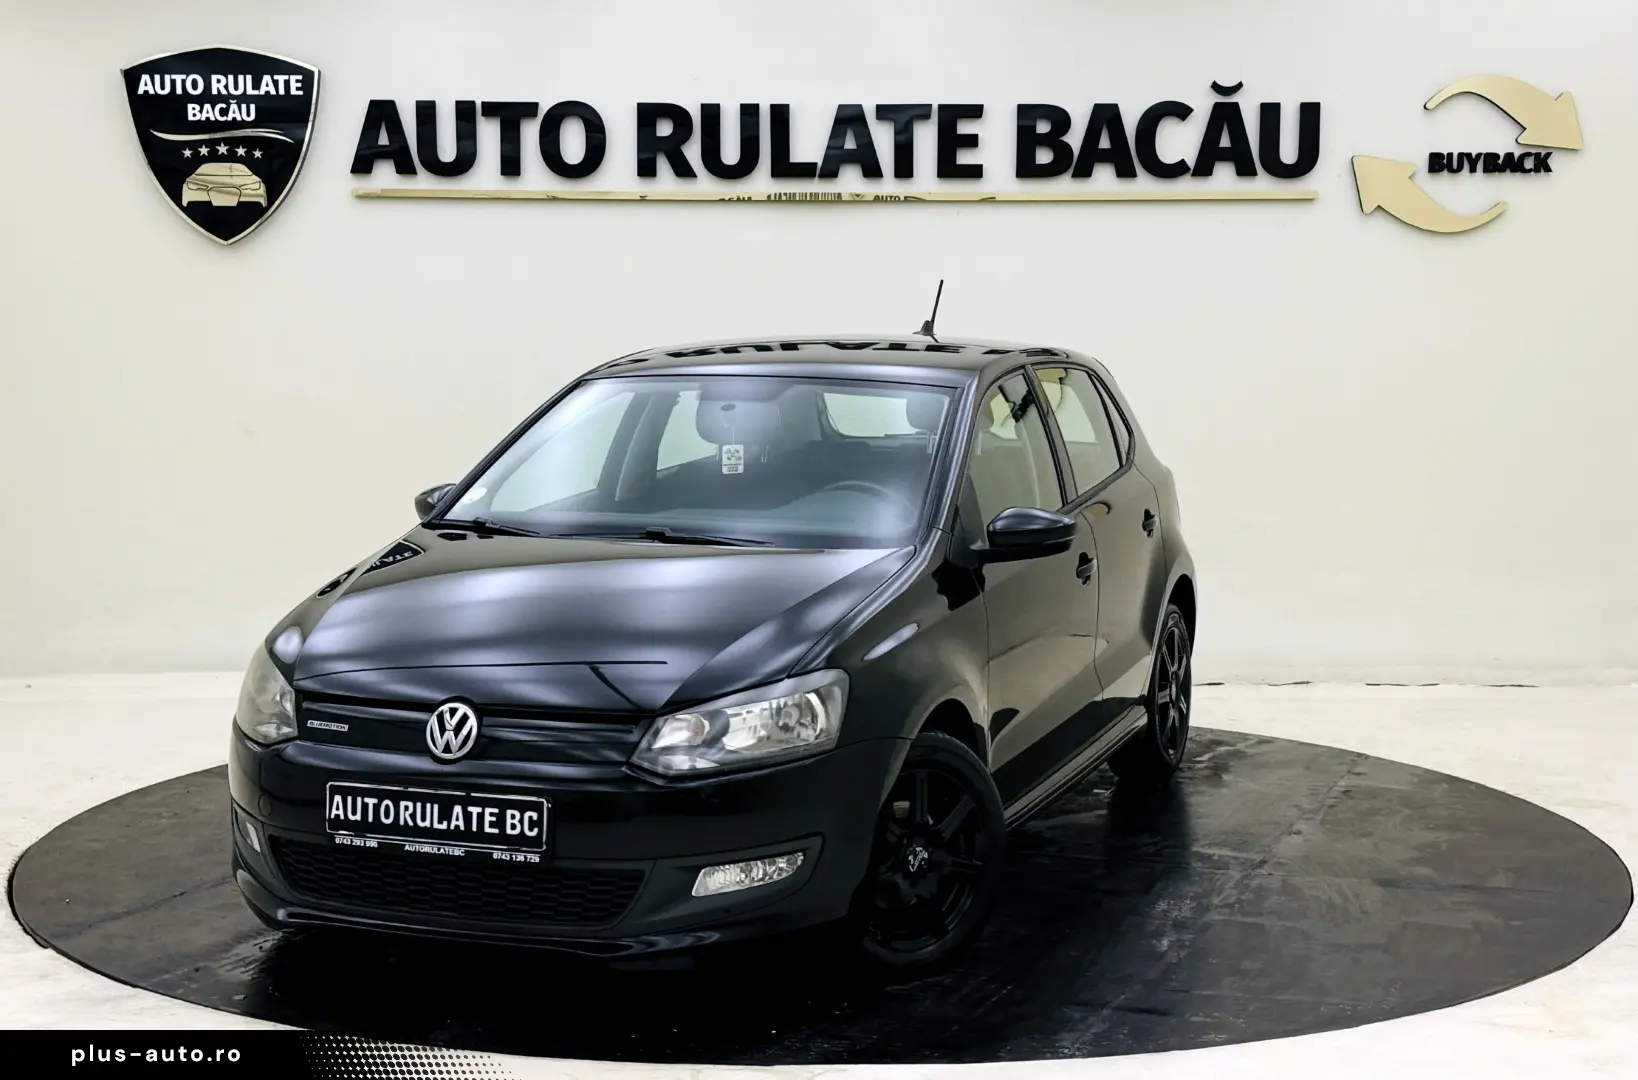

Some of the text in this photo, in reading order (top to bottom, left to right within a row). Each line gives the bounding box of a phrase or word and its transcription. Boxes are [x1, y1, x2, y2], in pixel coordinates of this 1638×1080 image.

[138, 74, 303, 95] AUTO RULATE
[187, 100, 255, 121] BACĂU
[350, 81, 1320, 180] AUTO RULATE BACĂU
[1428, 152, 1553, 173] BUYBACK
[427, 702, 477, 759] VW
[506, 810, 538, 836] BC
[492, 852, 510, 860] 0743
